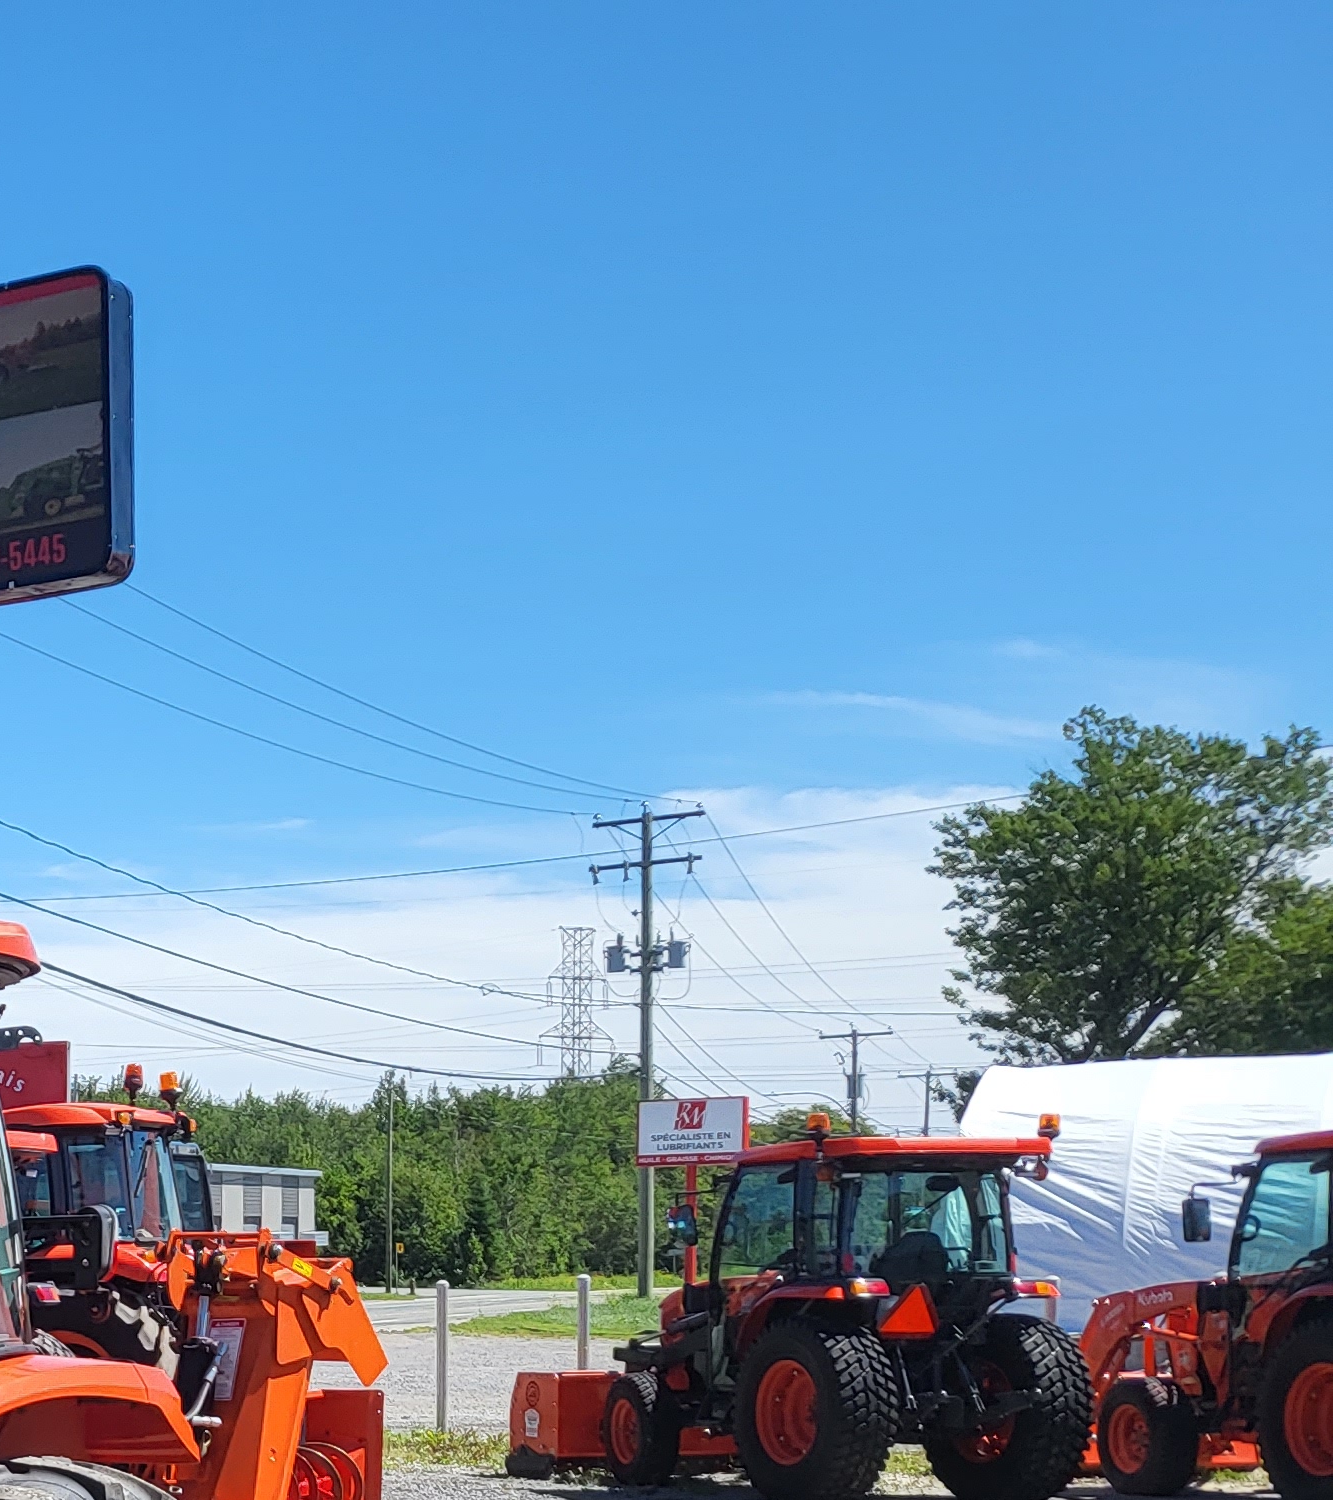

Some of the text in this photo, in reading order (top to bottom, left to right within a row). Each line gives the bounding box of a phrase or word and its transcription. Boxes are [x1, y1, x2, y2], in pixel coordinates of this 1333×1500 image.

[650, 1131, 732, 1142] SPÉCIALISTE EN
[656, 1141, 724, 1151] LUBRIFIANTS
